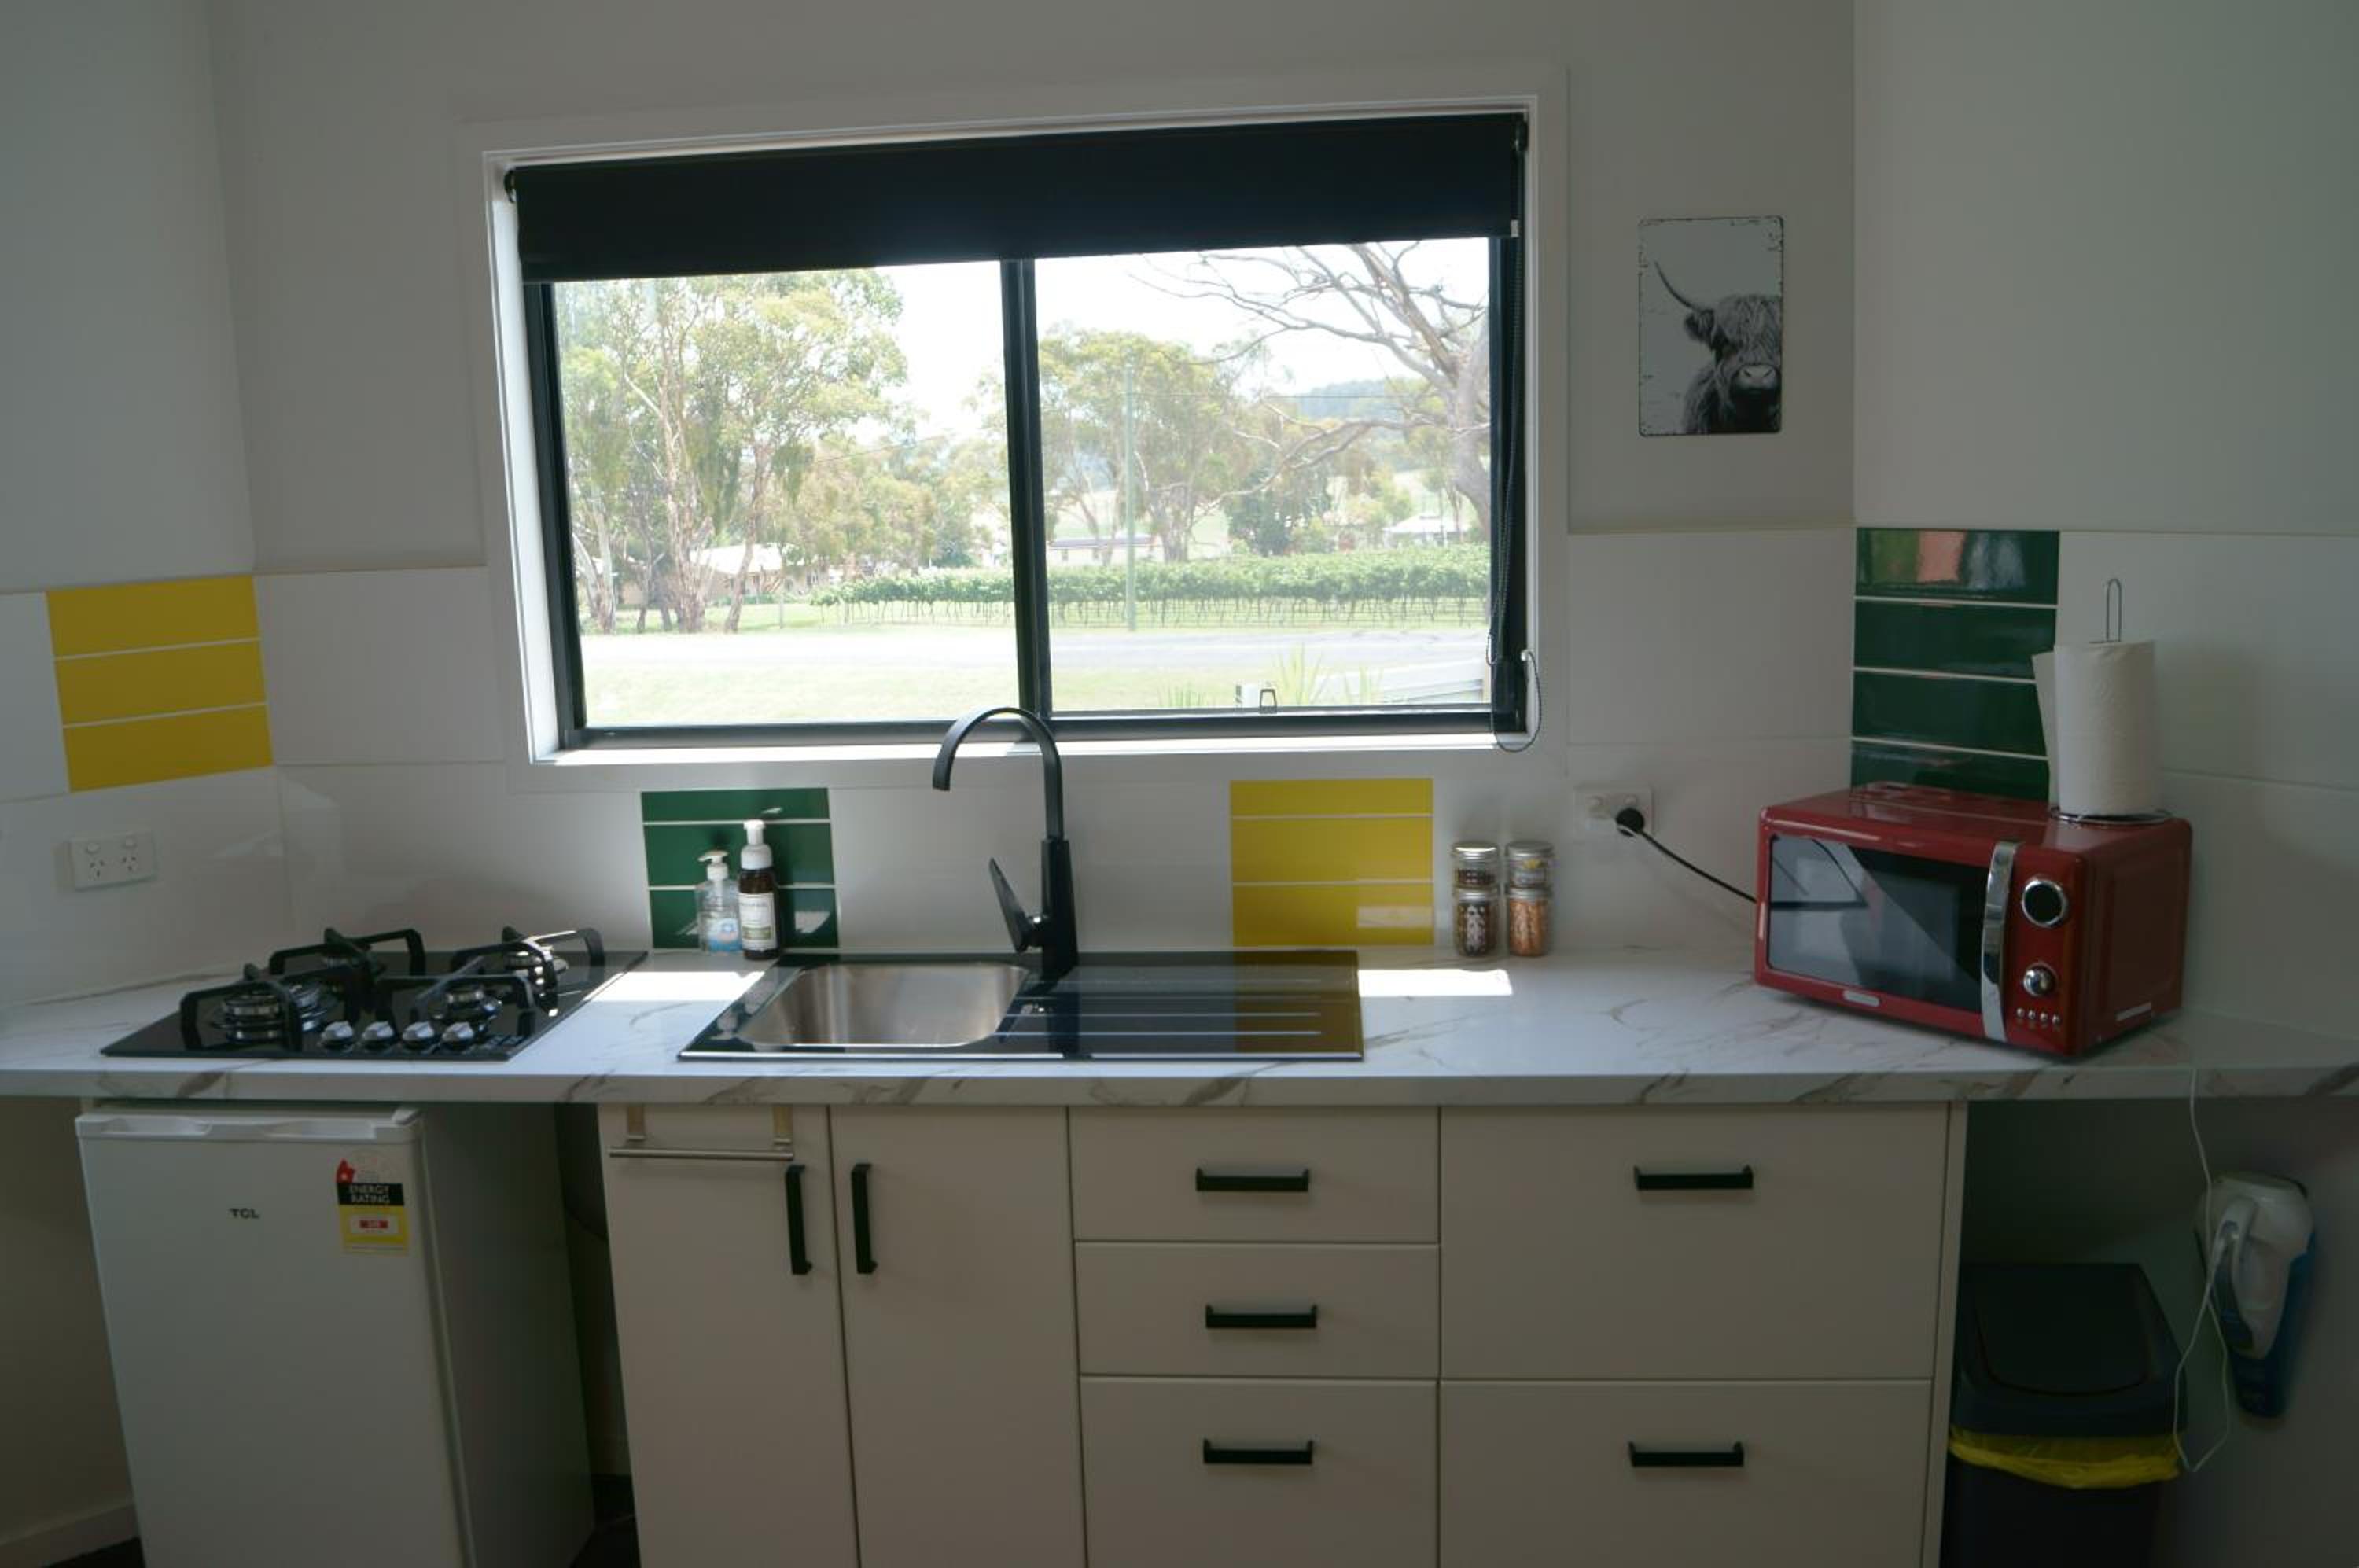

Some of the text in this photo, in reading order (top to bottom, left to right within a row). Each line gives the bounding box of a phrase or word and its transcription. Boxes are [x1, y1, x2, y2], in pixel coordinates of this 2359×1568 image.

[349, 1185, 390, 1194] ENERGY
[351, 1194, 390, 1203] RATING
[229, 1208, 259, 1219] TCL
